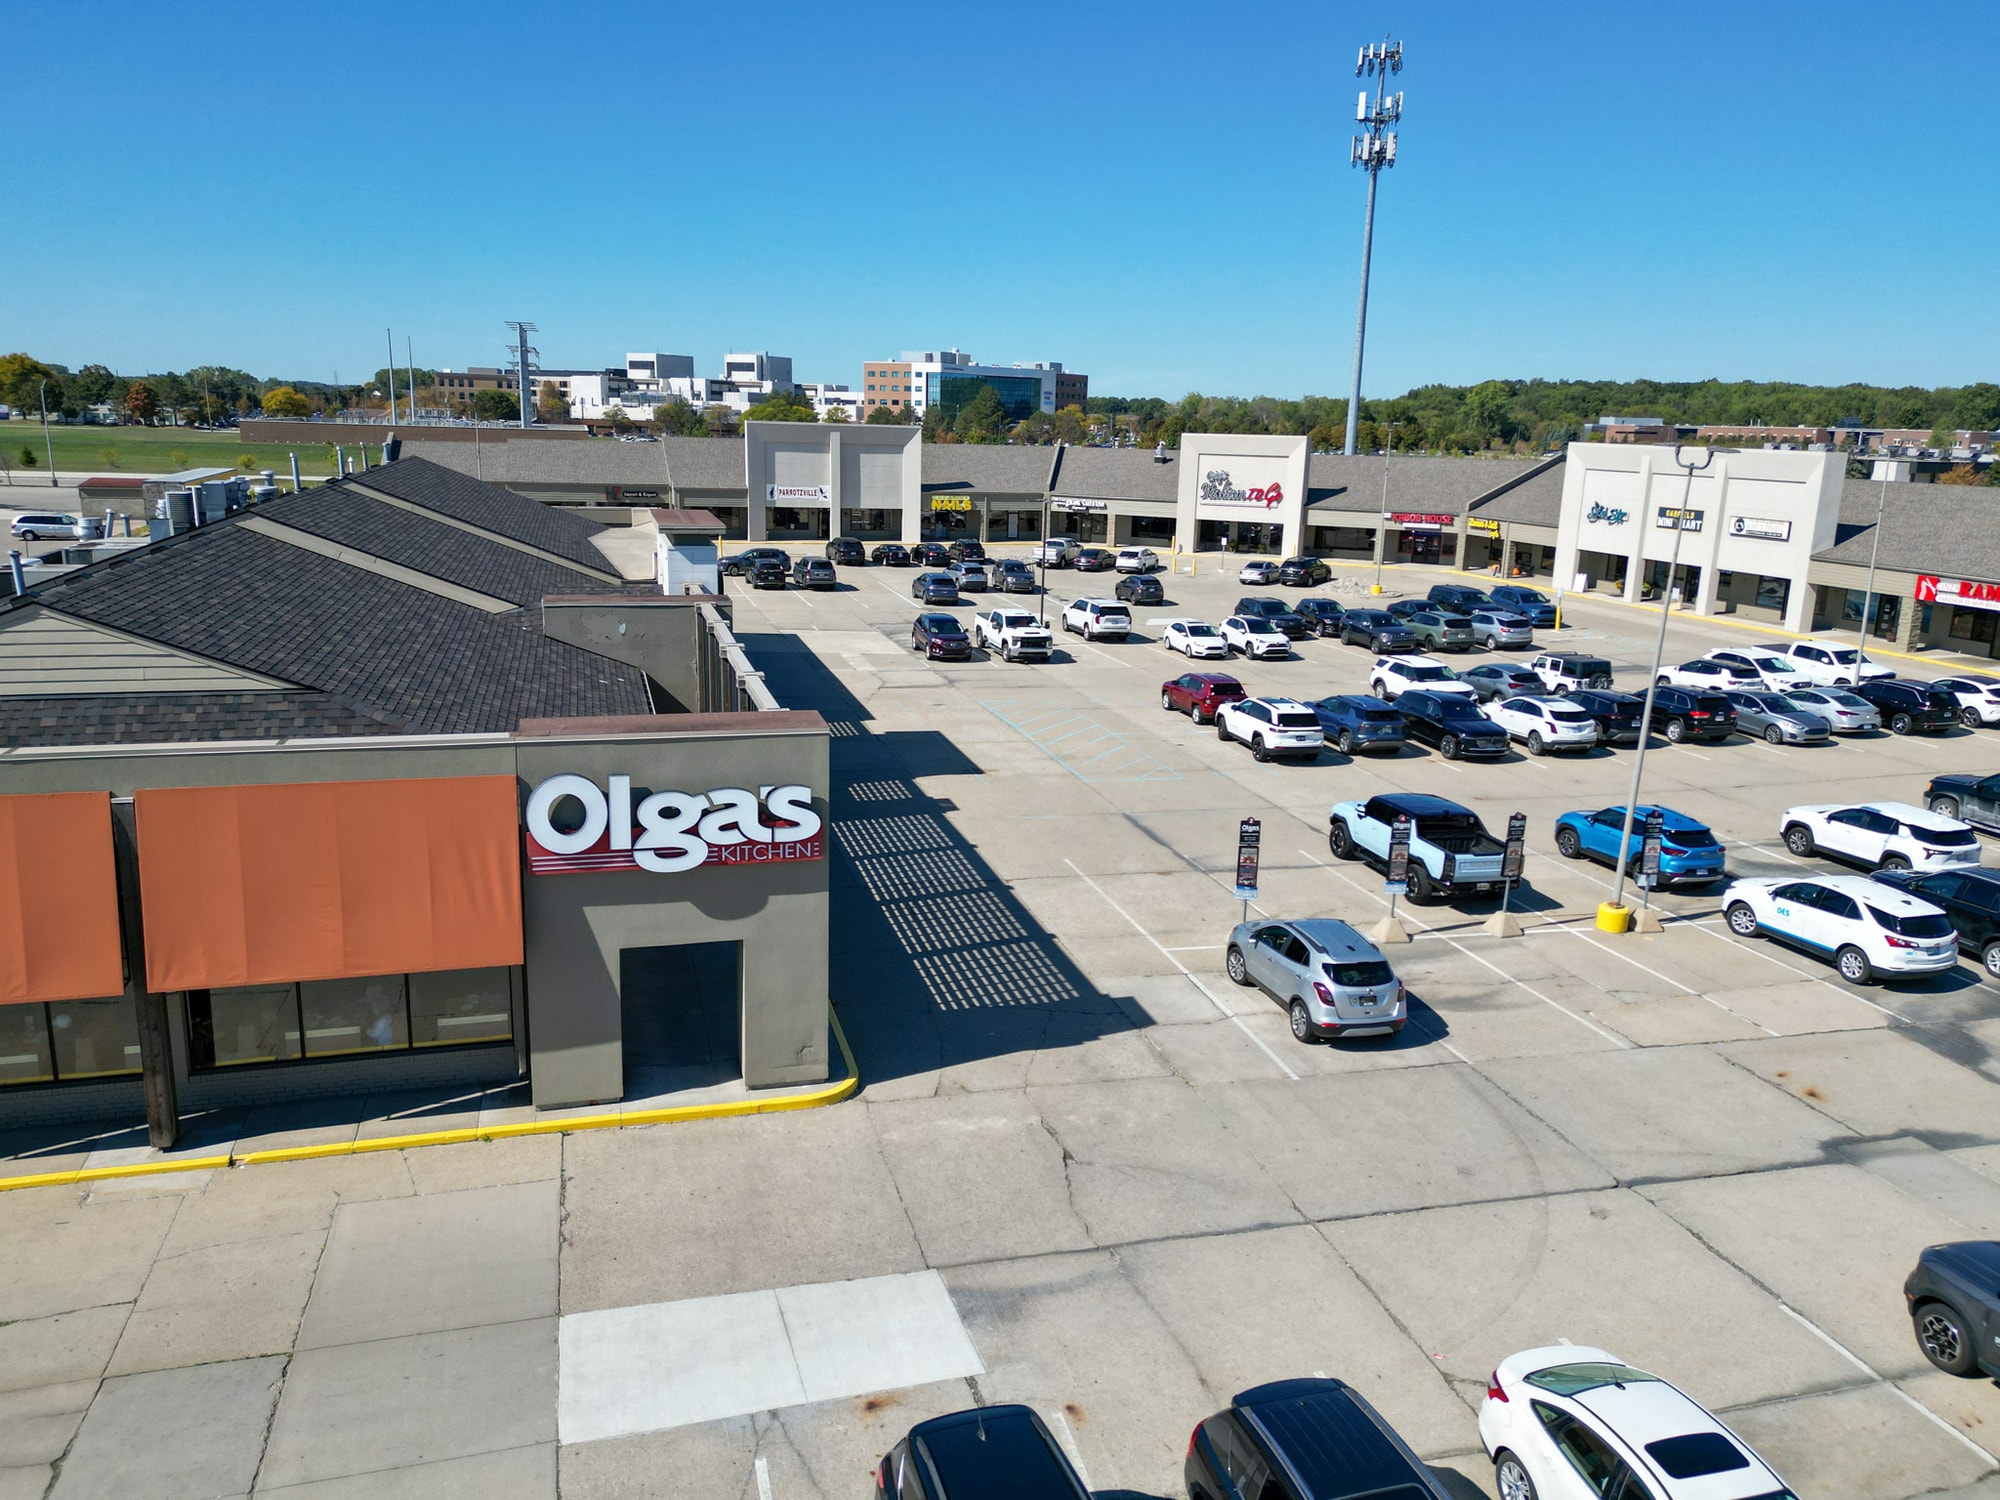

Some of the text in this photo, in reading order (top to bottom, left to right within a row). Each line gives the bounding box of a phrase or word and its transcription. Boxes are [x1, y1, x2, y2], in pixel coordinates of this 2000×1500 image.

[778, 488, 818, 497] PARROTZVILLE
[1200, 480, 1247, 501] Italian
[931, 499, 972, 511] NAILS
[1391, 512, 1422, 522] KABOB
[1423, 514, 1453, 524] HOUSE
[1665, 509, 1695, 519] GARFELD
[1657, 516, 1674, 527] MINI
[526, 773, 822, 873] Olga's
[721, 843, 812, 862] KITCHEN
[1777, 907, 1790, 917] DES
